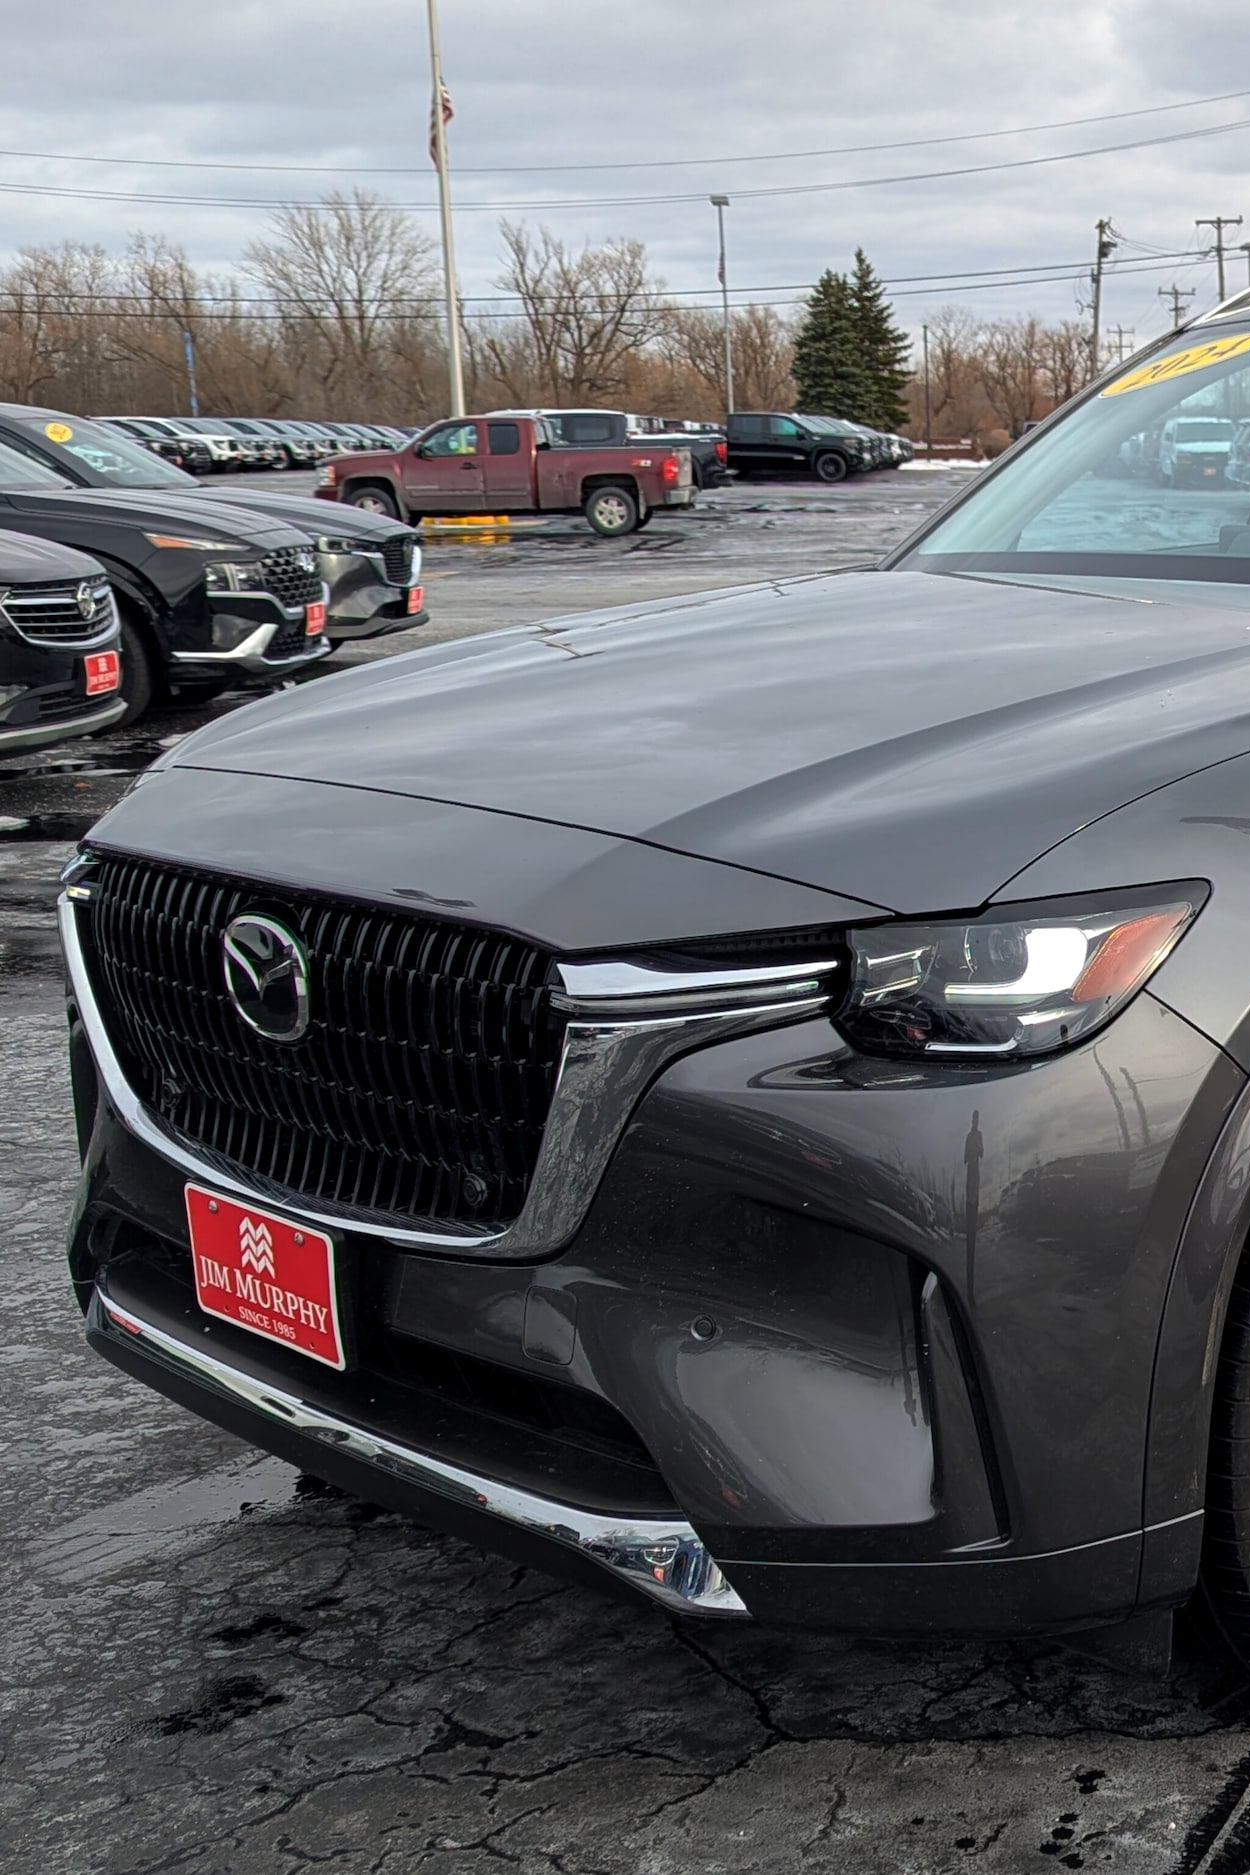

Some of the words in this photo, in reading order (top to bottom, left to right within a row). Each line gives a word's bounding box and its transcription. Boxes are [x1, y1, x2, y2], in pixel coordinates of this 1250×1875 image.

[199, 1255, 232, 1293] JIM
[233, 1268, 328, 1334] MURPHY
[238, 1306, 271, 1330] SINCE
[273, 1319, 296, 1340] 1985
